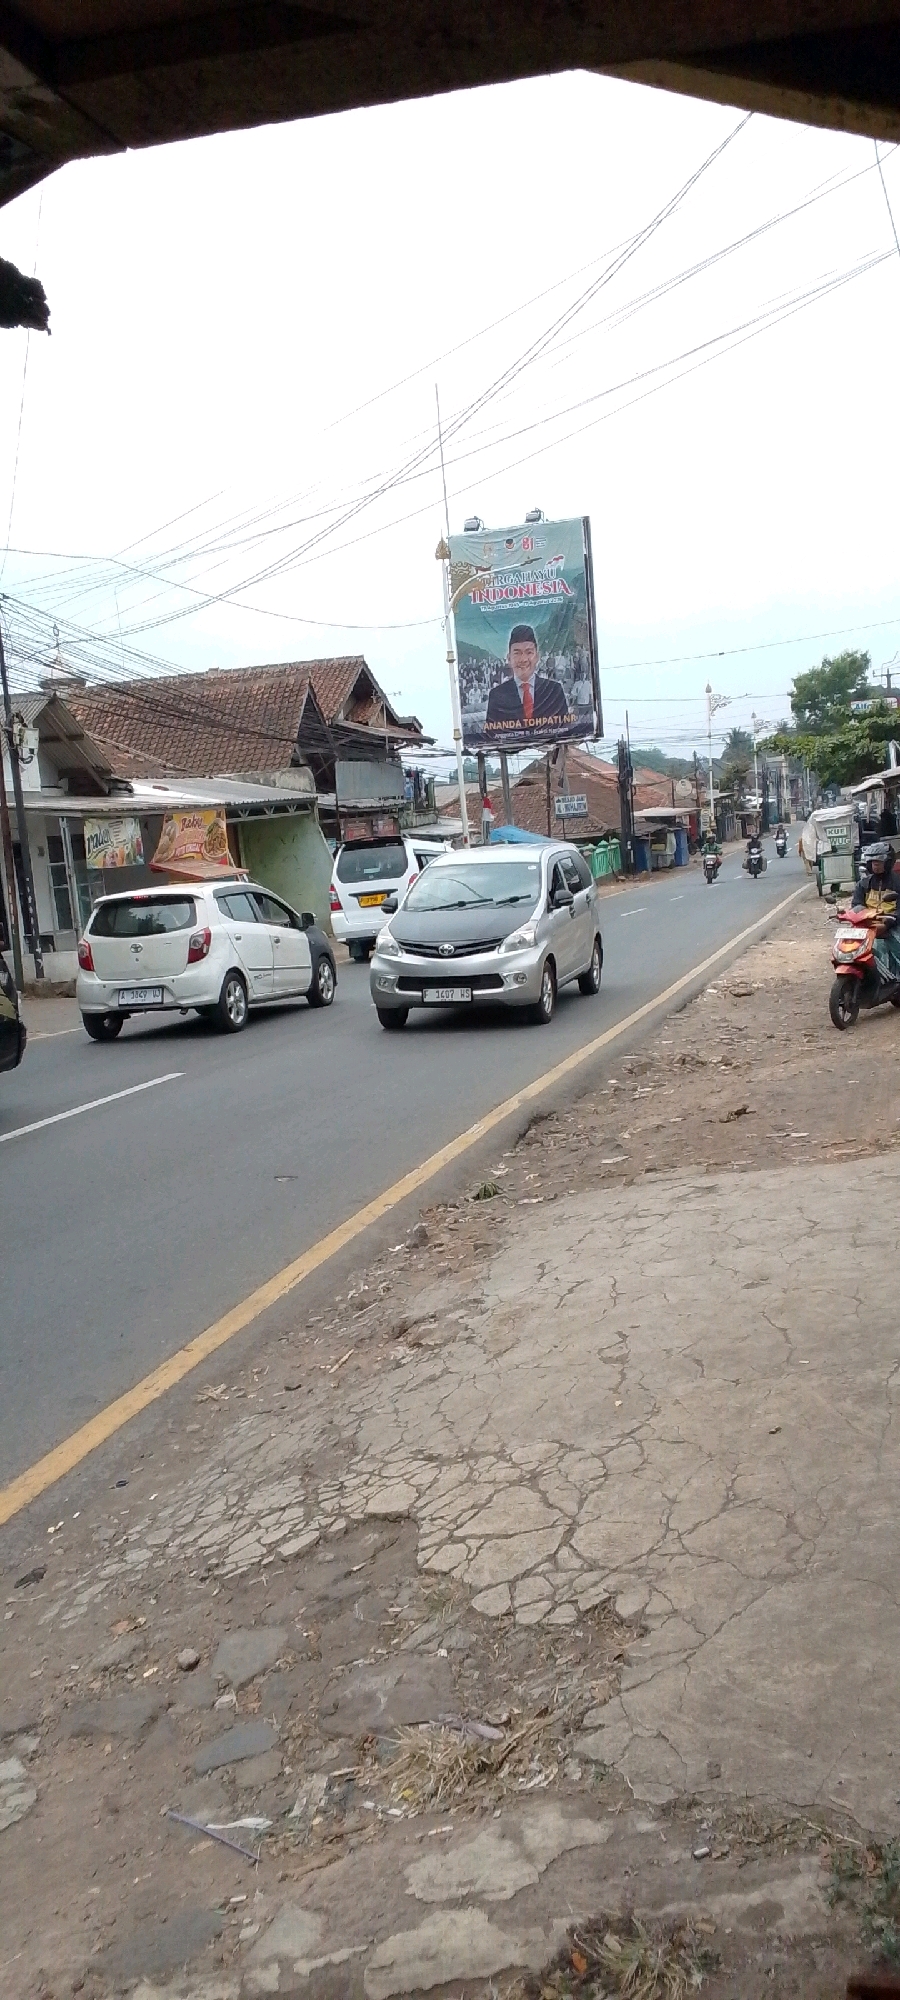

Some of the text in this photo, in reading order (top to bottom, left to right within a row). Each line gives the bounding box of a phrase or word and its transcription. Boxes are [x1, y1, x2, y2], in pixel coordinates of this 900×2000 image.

[469, 578, 574, 605] INDONESIA
[483, 719, 522, 731] ANANDA
[120, 990, 126, 1000] A
[423, 990, 428, 999] F
